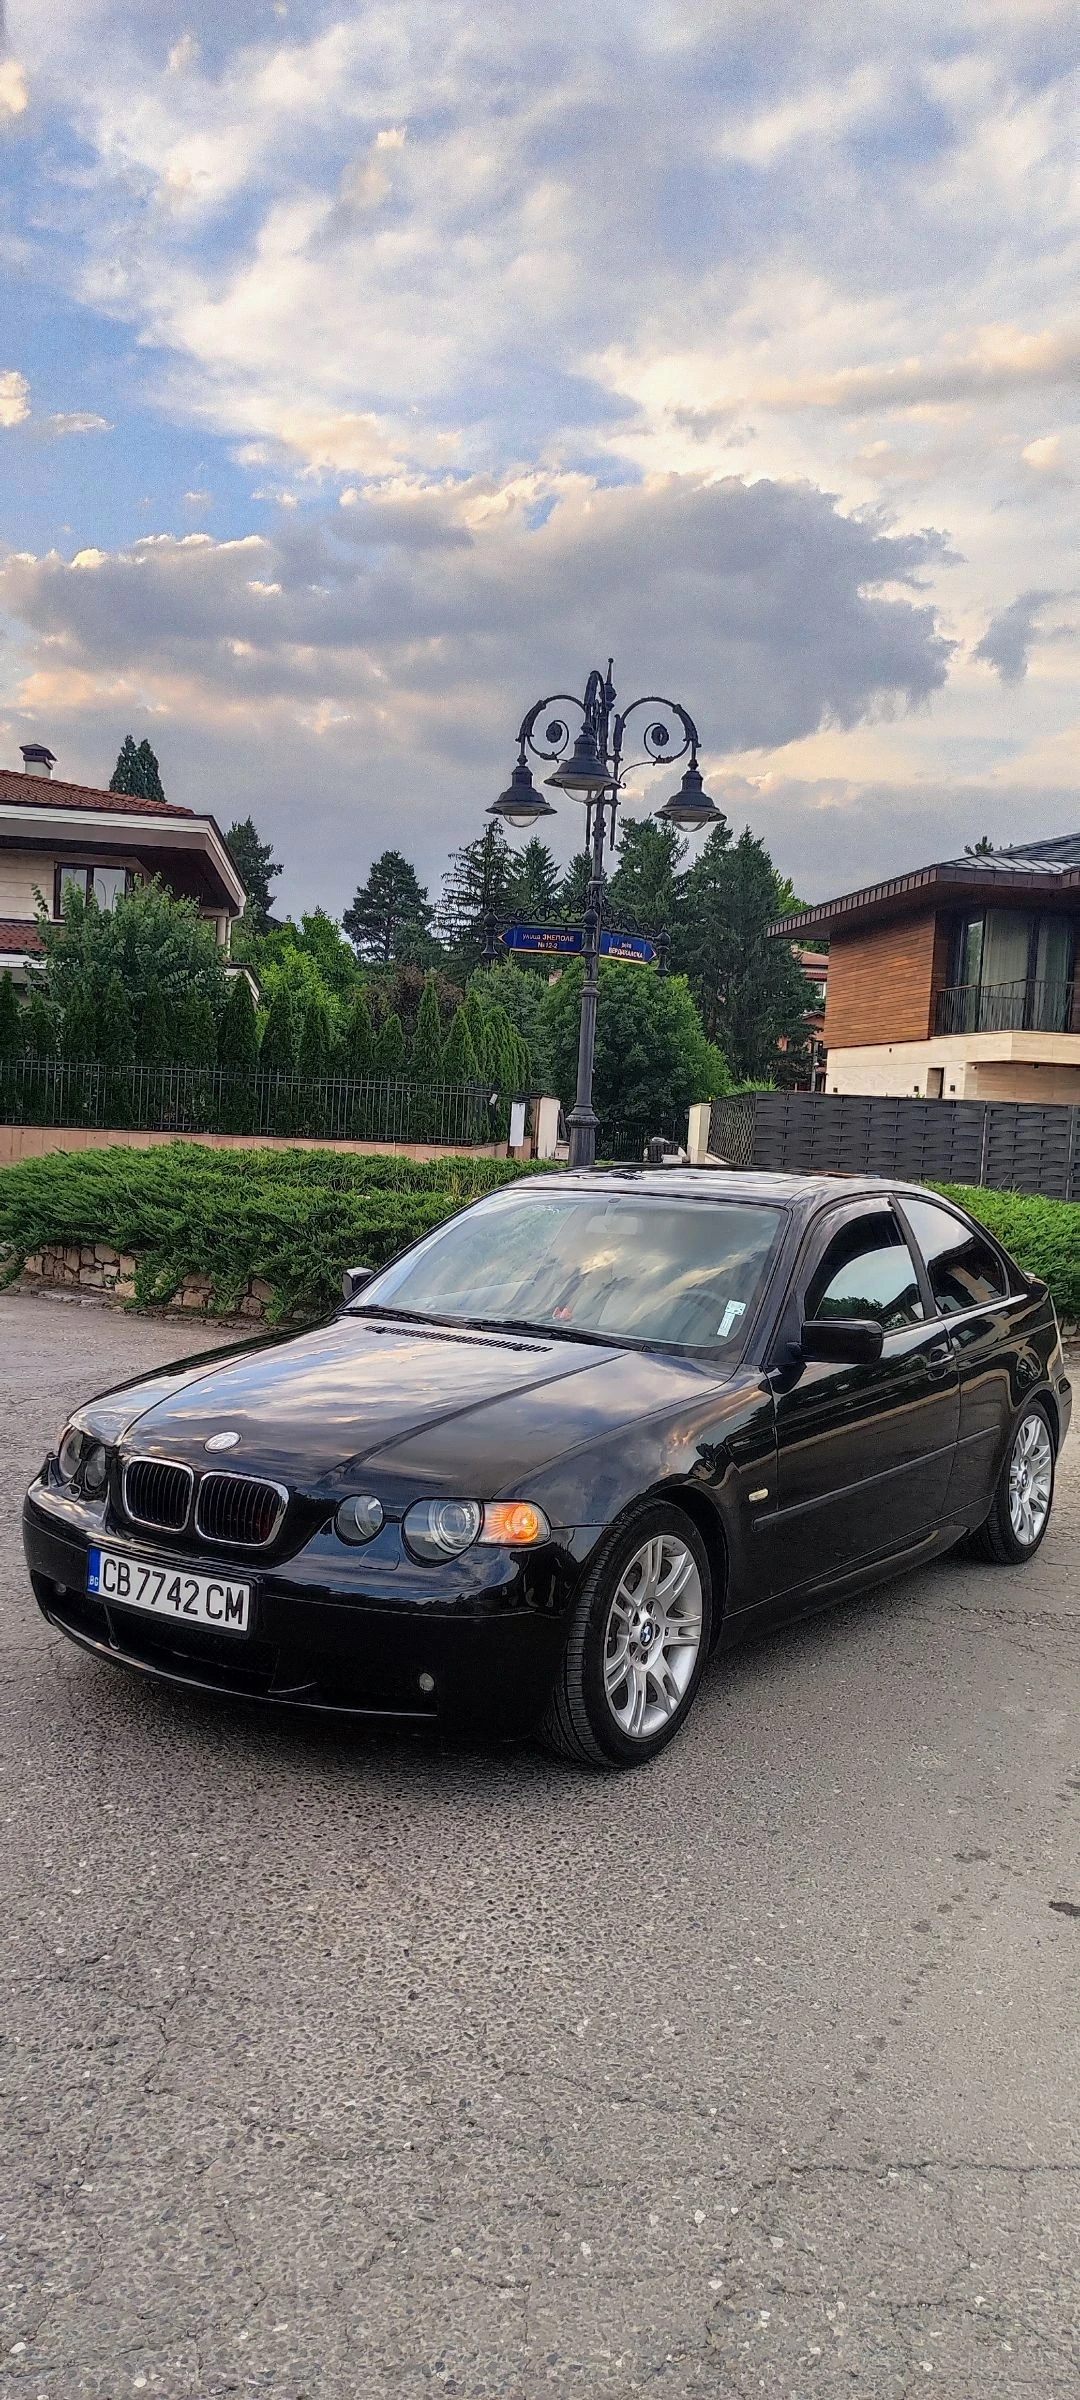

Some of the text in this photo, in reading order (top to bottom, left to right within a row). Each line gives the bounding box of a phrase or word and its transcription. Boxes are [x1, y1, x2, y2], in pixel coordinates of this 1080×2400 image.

[89, 1575, 99, 1587] BG
[103, 1558, 244, 1625] CB 7742 CM
